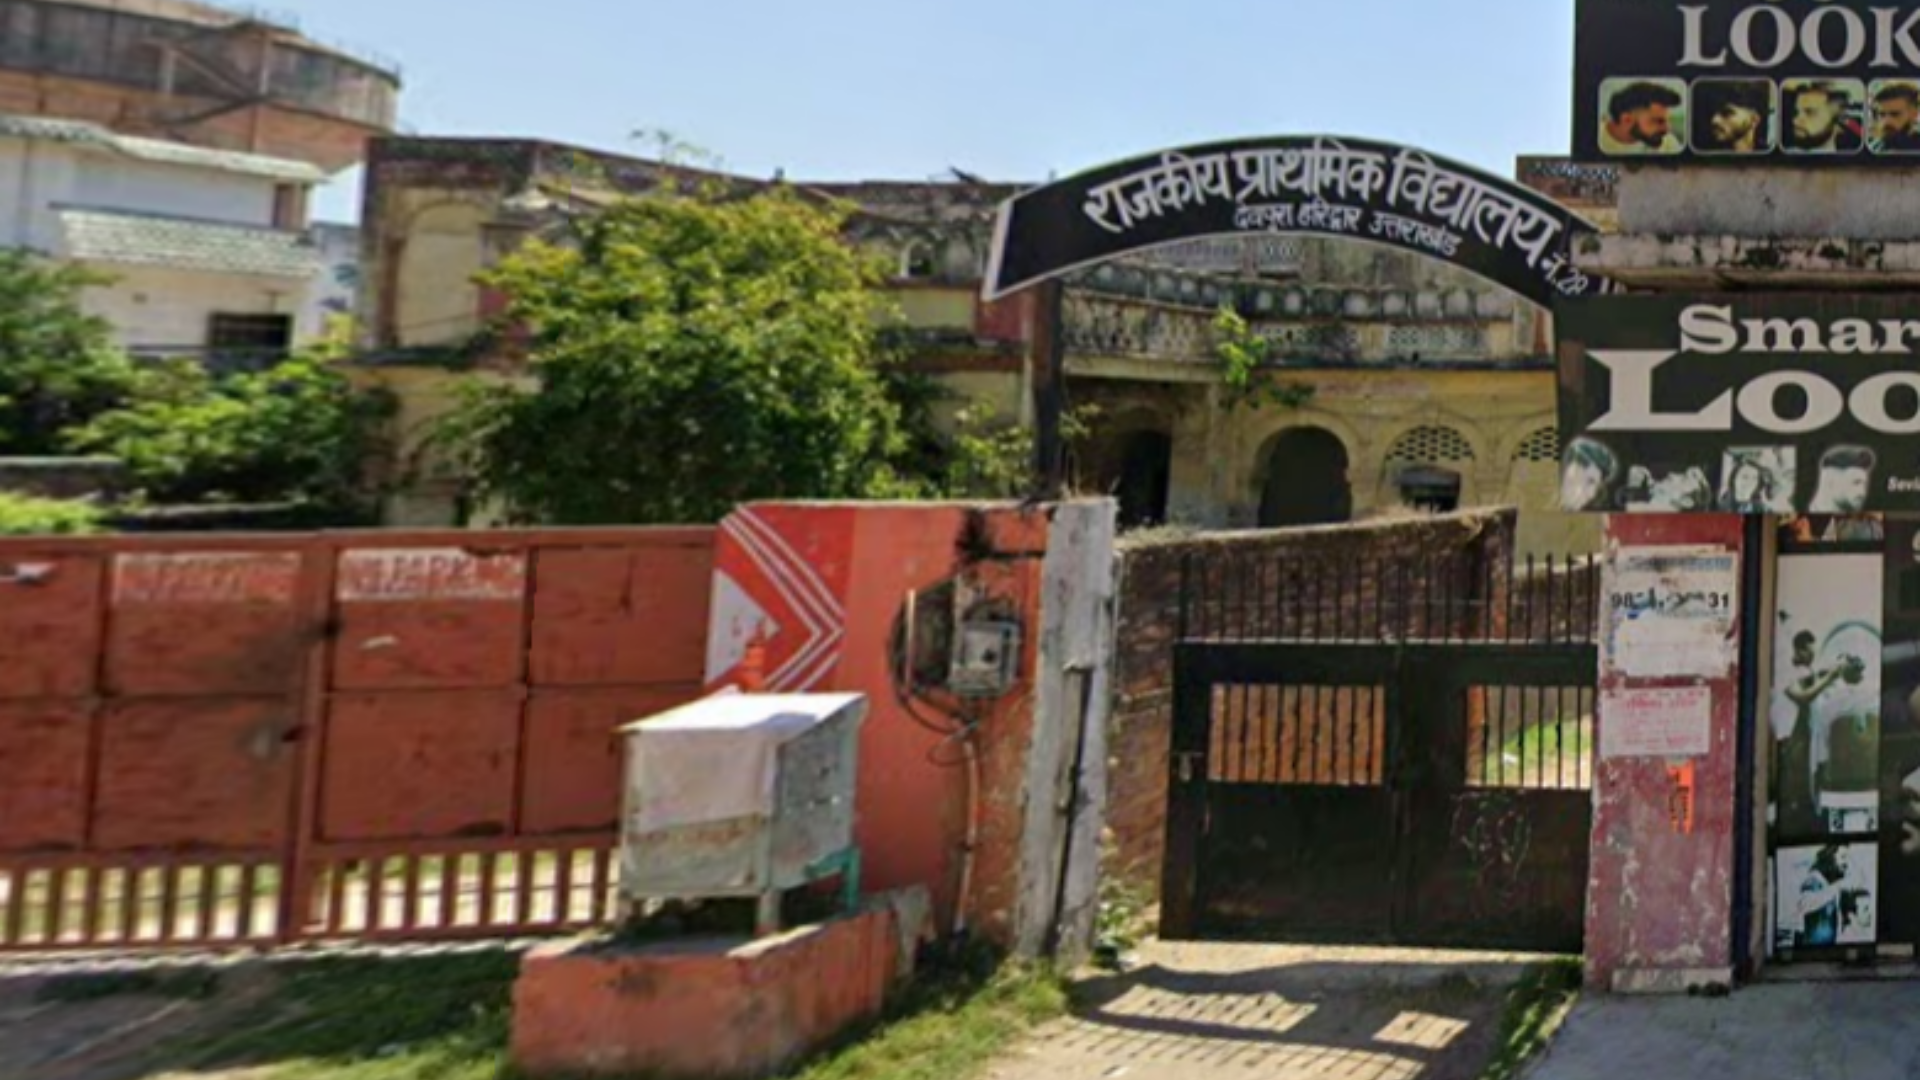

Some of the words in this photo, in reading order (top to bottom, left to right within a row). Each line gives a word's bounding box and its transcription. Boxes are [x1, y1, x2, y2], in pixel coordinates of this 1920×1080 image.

[1677, 5, 1920, 68] LOOK
[1083, 150, 1231, 232] राजकीय
[1232, 138, 1388, 202] प्राथमिक
[1391, 149, 1564, 267] विद्यालय
[1298, 198, 1361, 231] हरिद्वार
[1369, 211, 1462, 255] उत्तराखंड
